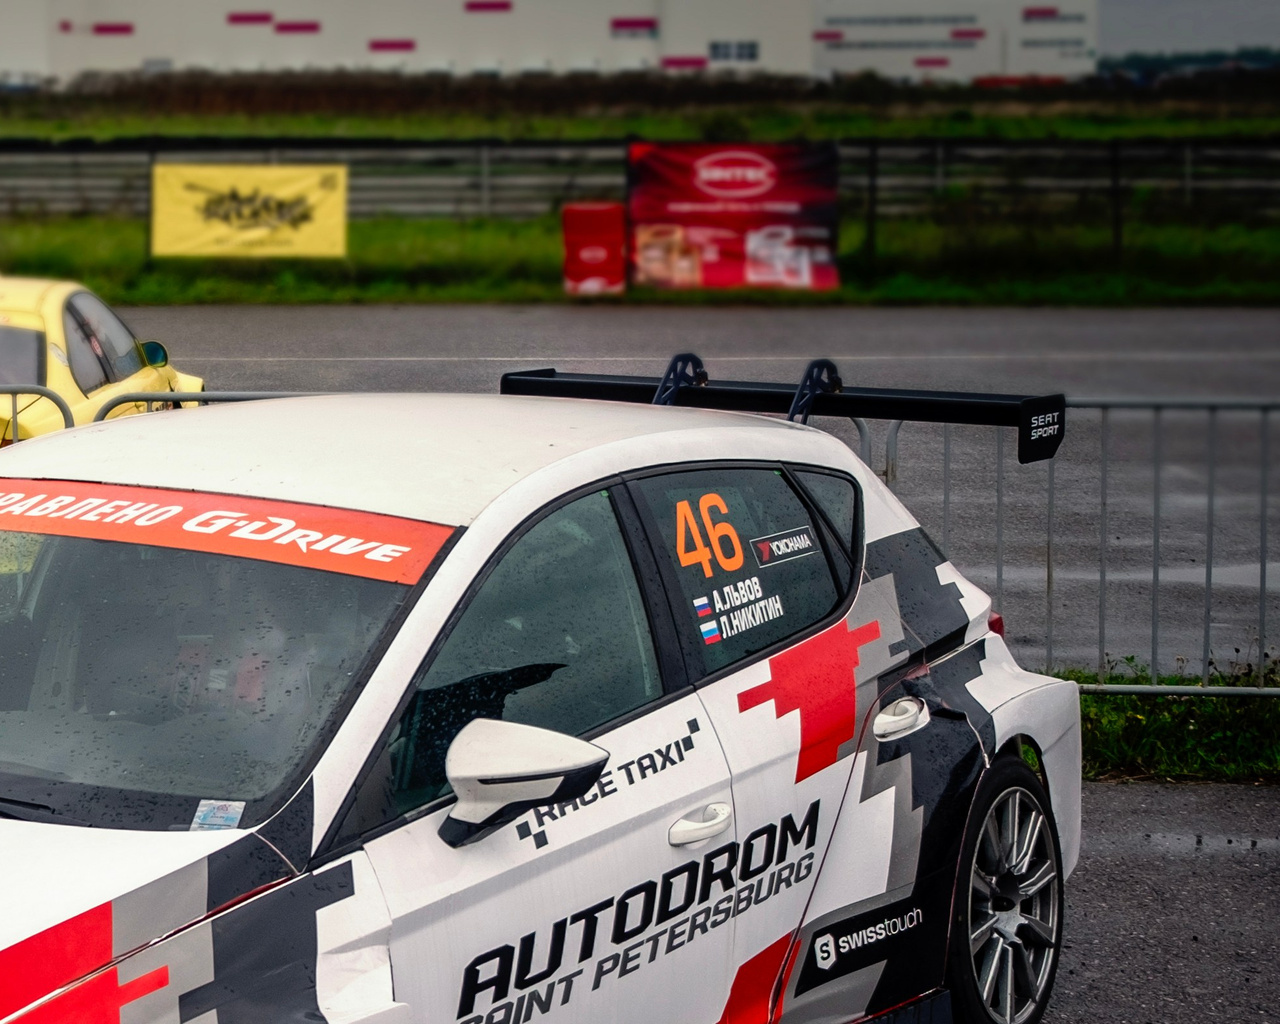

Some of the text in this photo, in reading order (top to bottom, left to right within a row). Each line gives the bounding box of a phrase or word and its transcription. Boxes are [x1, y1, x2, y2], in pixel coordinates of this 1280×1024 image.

[1031, 412, 1060, 427] SEAT
[1031, 425, 1060, 440] SPORT
[676, 493, 744, 578] 46
[769, 534, 813, 556] YOKOHAMA
[713, 576, 763, 613] А.ЛЬВОВ
[617, 739, 685, 786] TAXI
[457, 799, 820, 1020] AUTODROM
[591, 852, 814, 992] PETERSBURG
[838, 907, 923, 954] swisstouch
